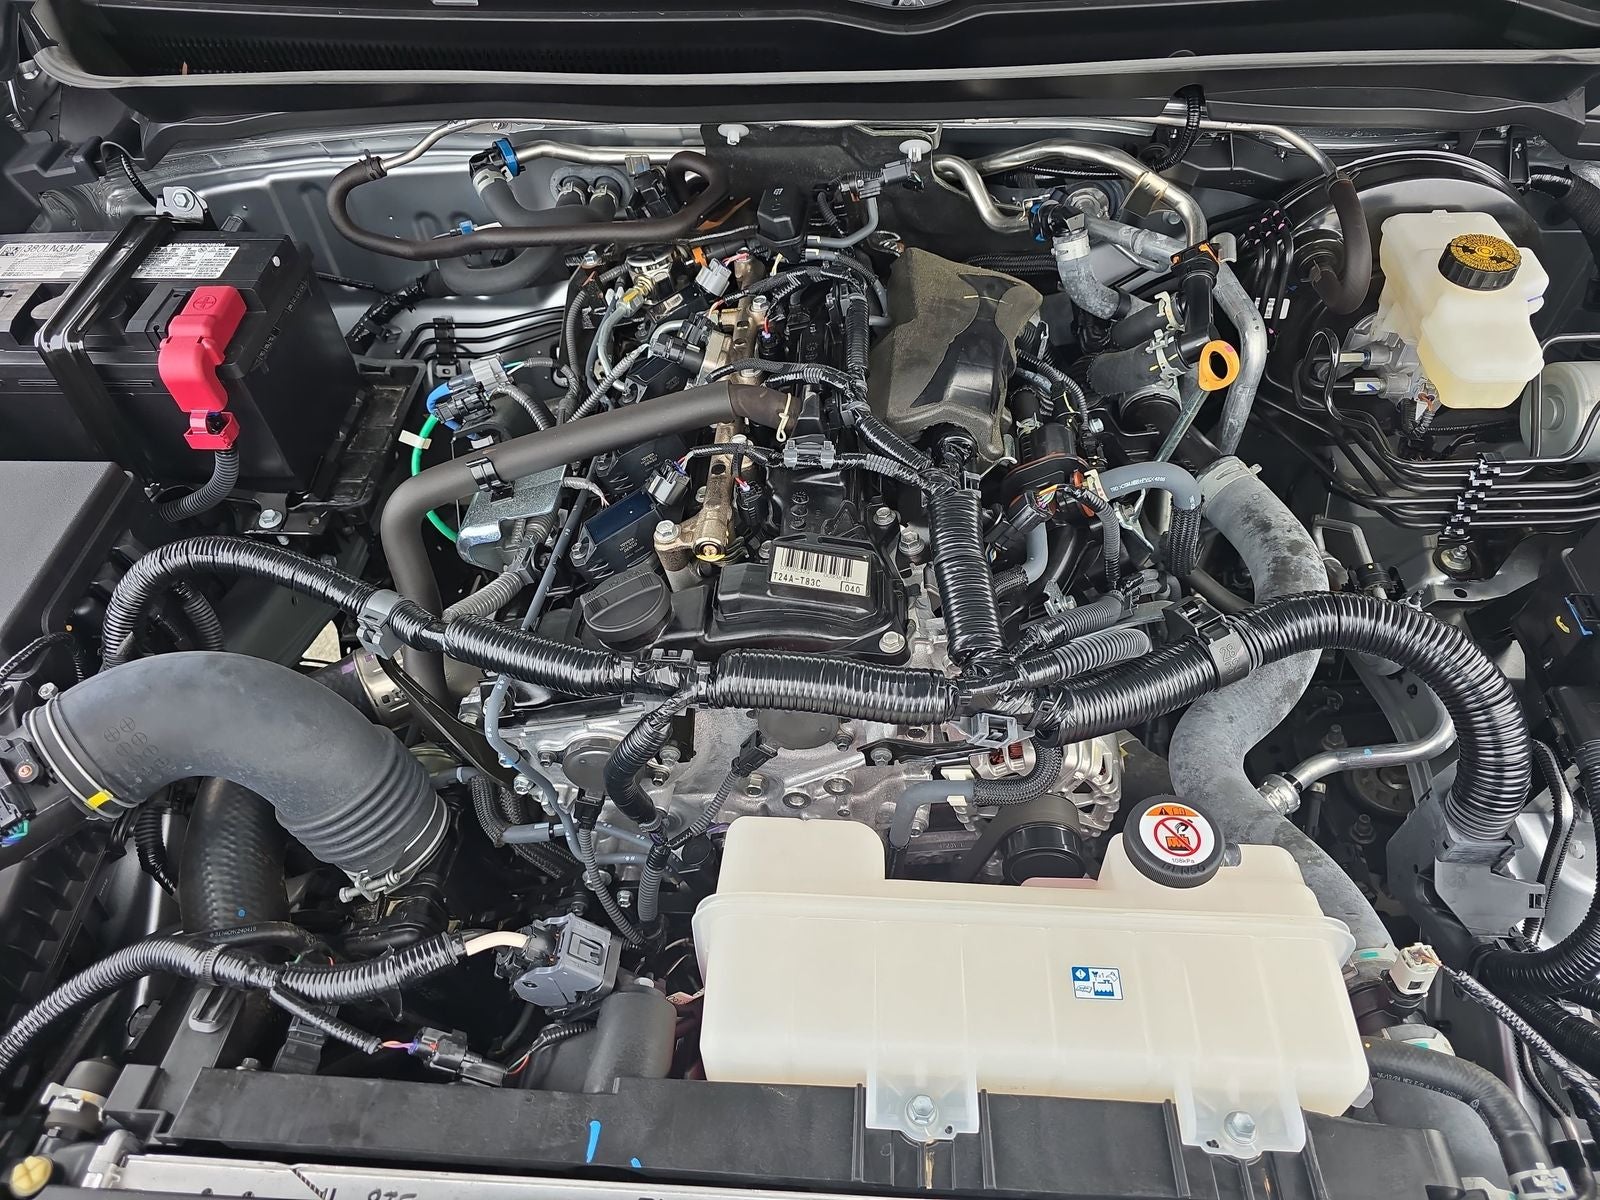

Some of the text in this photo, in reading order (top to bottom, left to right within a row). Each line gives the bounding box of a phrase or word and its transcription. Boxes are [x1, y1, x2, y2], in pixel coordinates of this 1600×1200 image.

[773, 571, 821, 588] T24A-T83C
[844, 584, 861, 594] 040
[1219, 643, 1238, 662] 28
